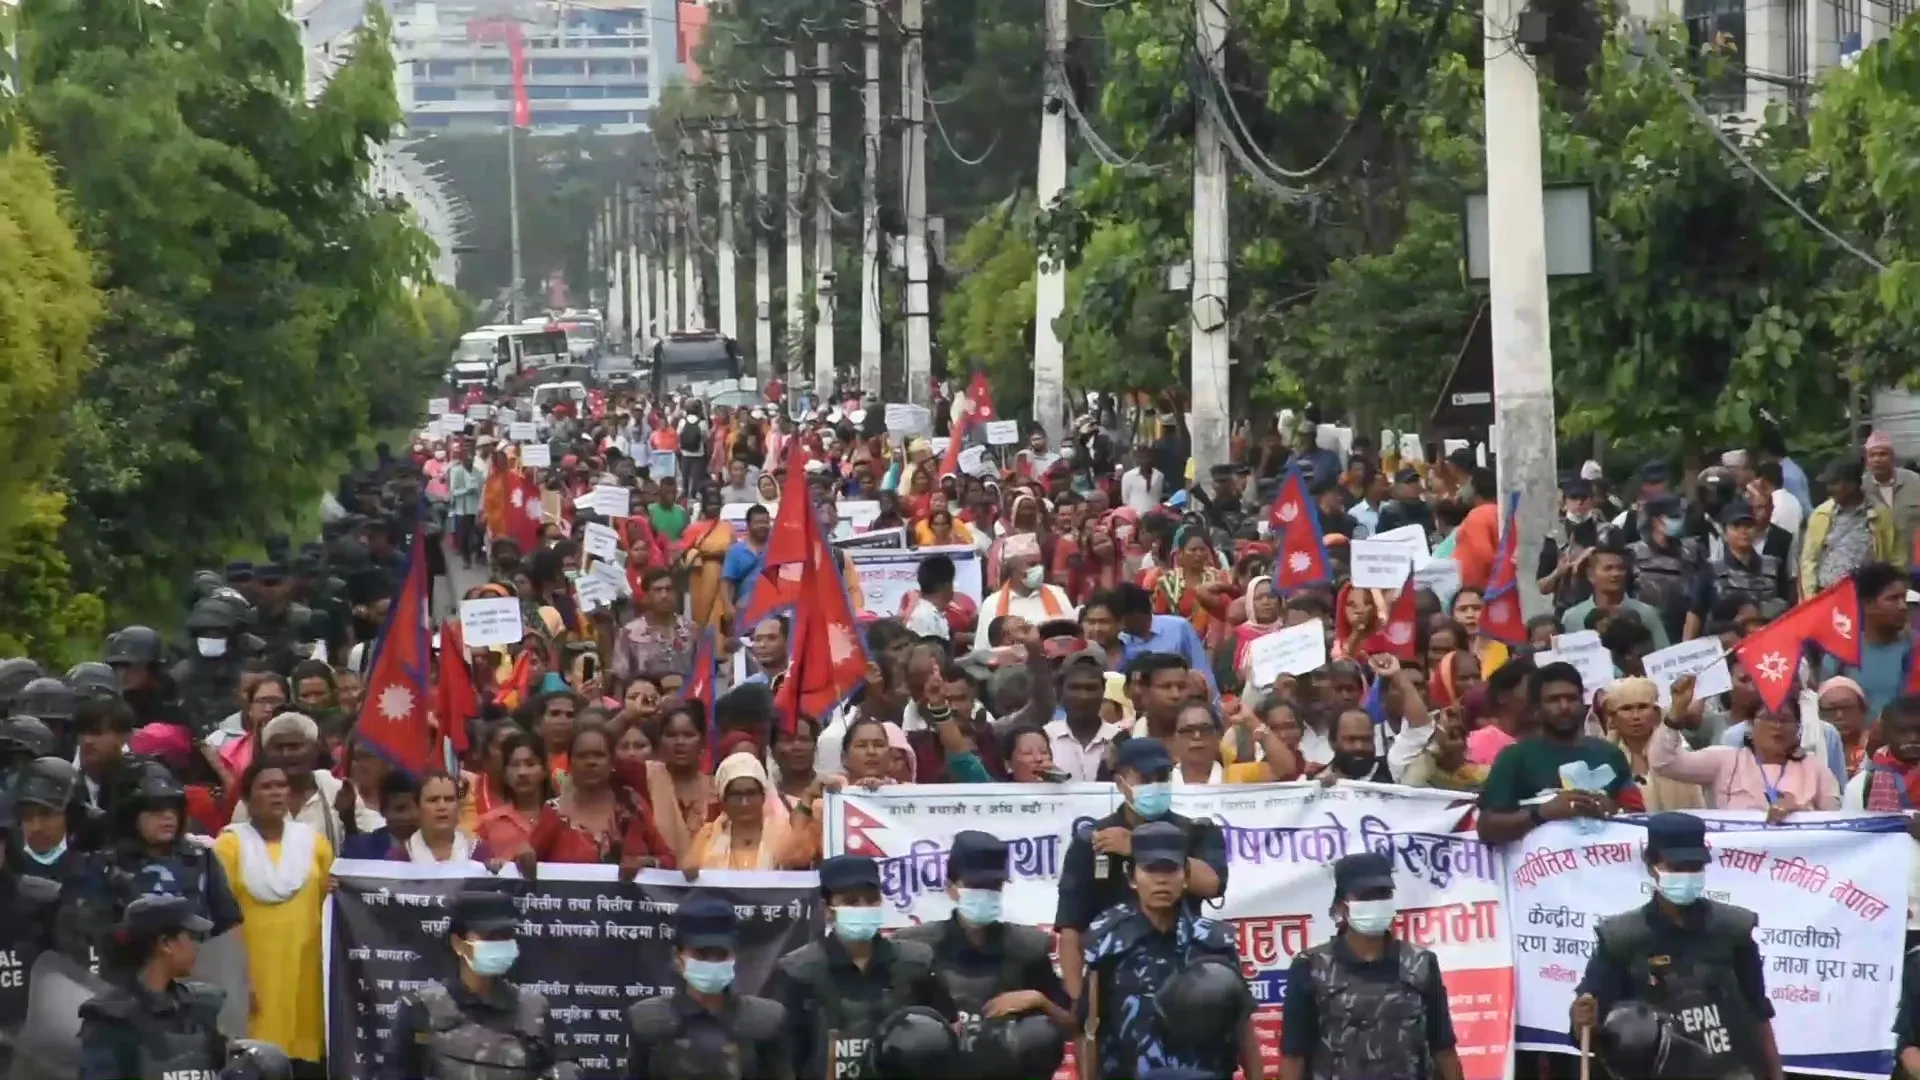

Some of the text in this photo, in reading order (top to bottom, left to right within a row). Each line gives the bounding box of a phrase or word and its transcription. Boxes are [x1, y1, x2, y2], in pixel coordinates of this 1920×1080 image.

[1001, 834, 1060, 880] था
[1212, 811, 1348, 865] ोषणको
[568, 897, 593, 912] तथा
[1828, 878, 1891, 922] नेपाल
[1390, 899, 1501, 947] नसभा
[1528, 902, 1588, 929] केन्द्रीय
[0, 949, 23, 967] AL
[1772, 955, 1810, 976] माग
[1851, 962, 1881, 983] गर
[0, 970, 24, 988] CE
[1704, 1028, 1732, 1055] ICE
